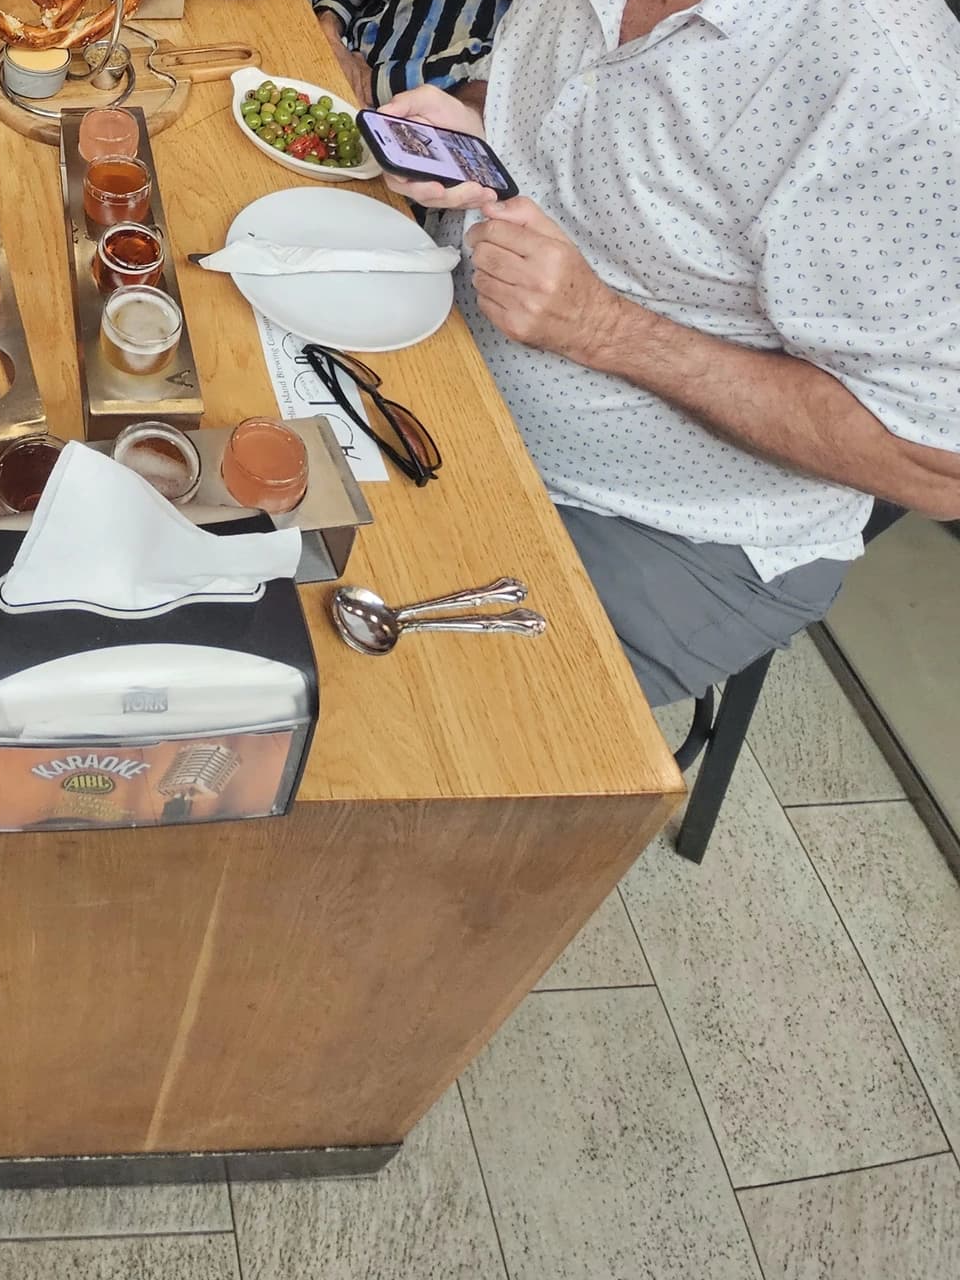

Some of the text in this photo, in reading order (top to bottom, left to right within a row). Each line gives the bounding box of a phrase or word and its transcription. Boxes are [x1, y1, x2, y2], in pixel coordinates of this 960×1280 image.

[271, 348, 285, 379] Brewing
[279, 380, 292, 404] Island
[31, 754, 151, 779] KARAOKE
